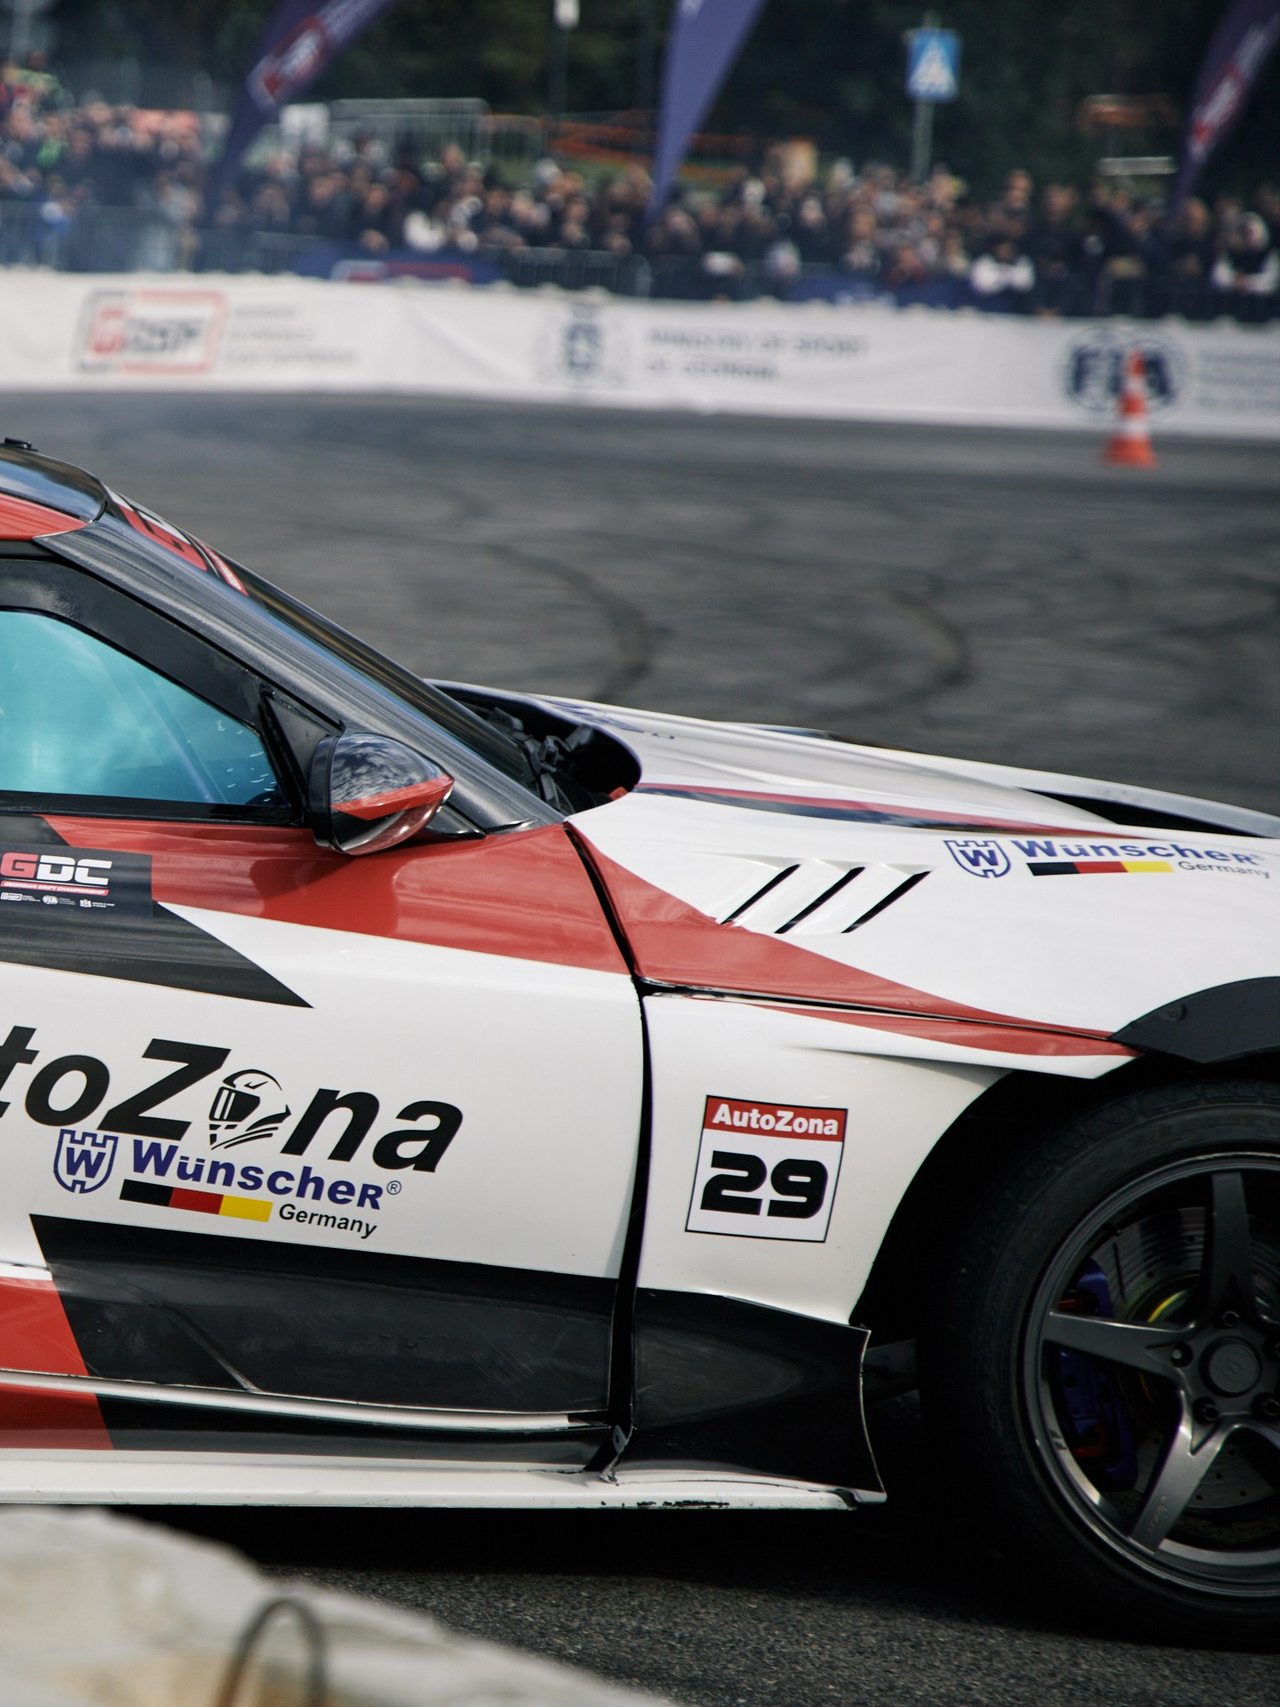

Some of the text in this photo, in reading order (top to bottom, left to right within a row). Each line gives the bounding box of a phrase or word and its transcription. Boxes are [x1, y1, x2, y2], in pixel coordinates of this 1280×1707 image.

[0, 852, 113, 886] GDC
[1178, 860, 1271, 879] Germany
[712, 1103, 839, 1136] AutoZona
[700, 1150, 828, 1219] 29
[278, 1203, 378, 1240] Germany
